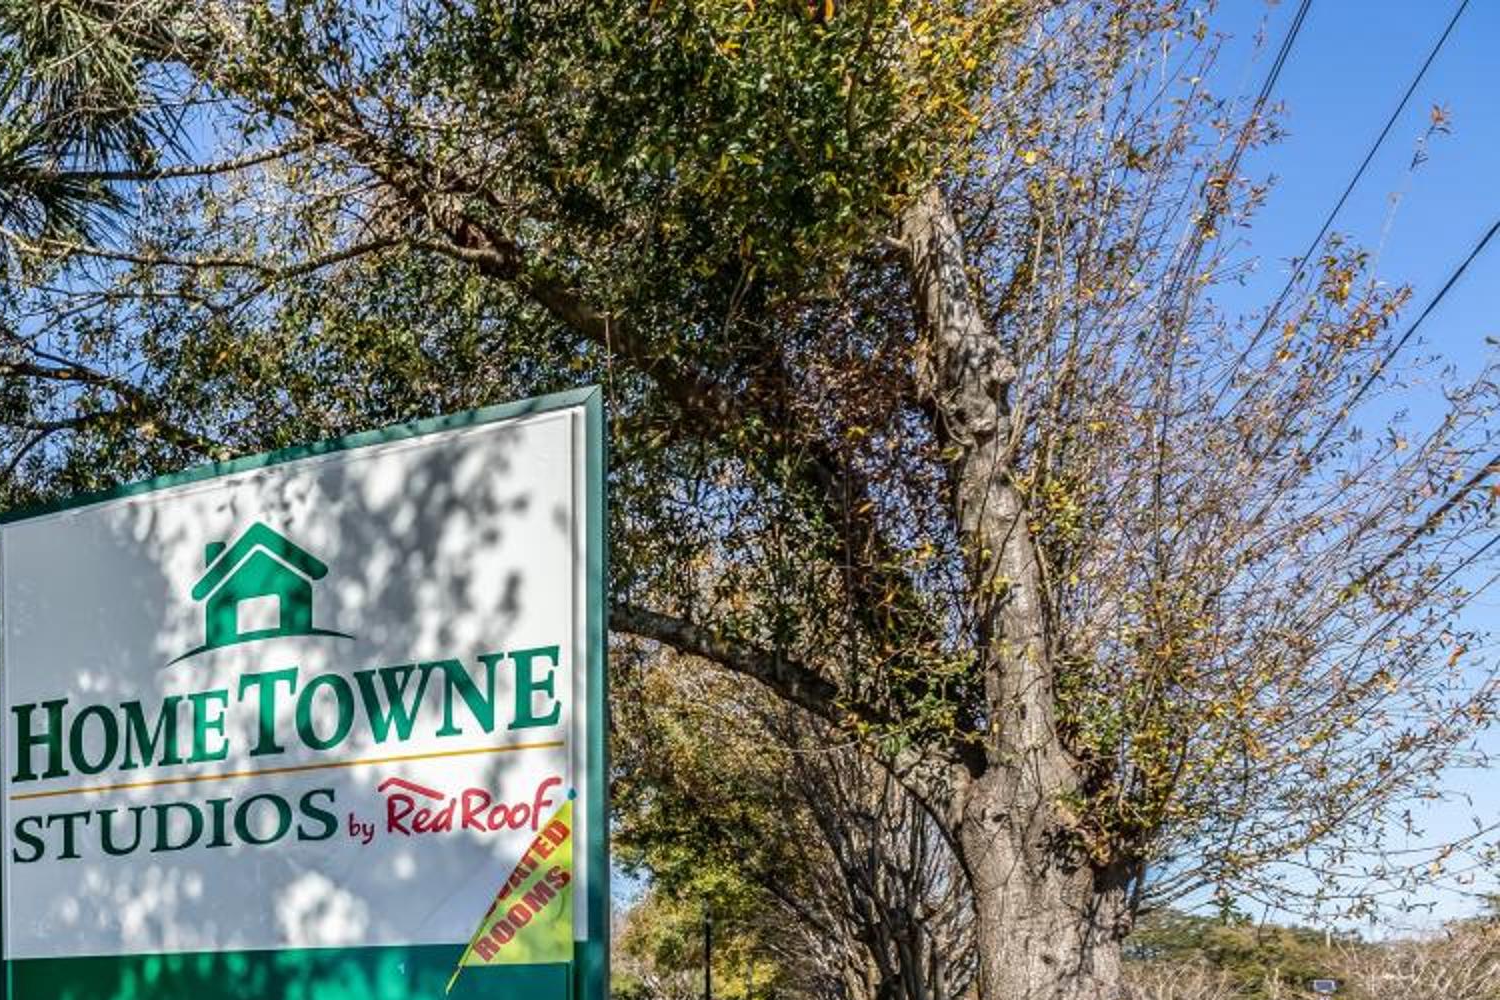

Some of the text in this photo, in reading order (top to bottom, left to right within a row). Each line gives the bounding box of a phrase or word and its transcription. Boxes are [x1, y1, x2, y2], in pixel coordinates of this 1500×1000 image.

[10, 644, 562, 784] HOMETOWNE
[11, 788, 340, 866] STUDIOS
[348, 813, 375, 845] by
[473, 865, 571, 962] ROOMS
